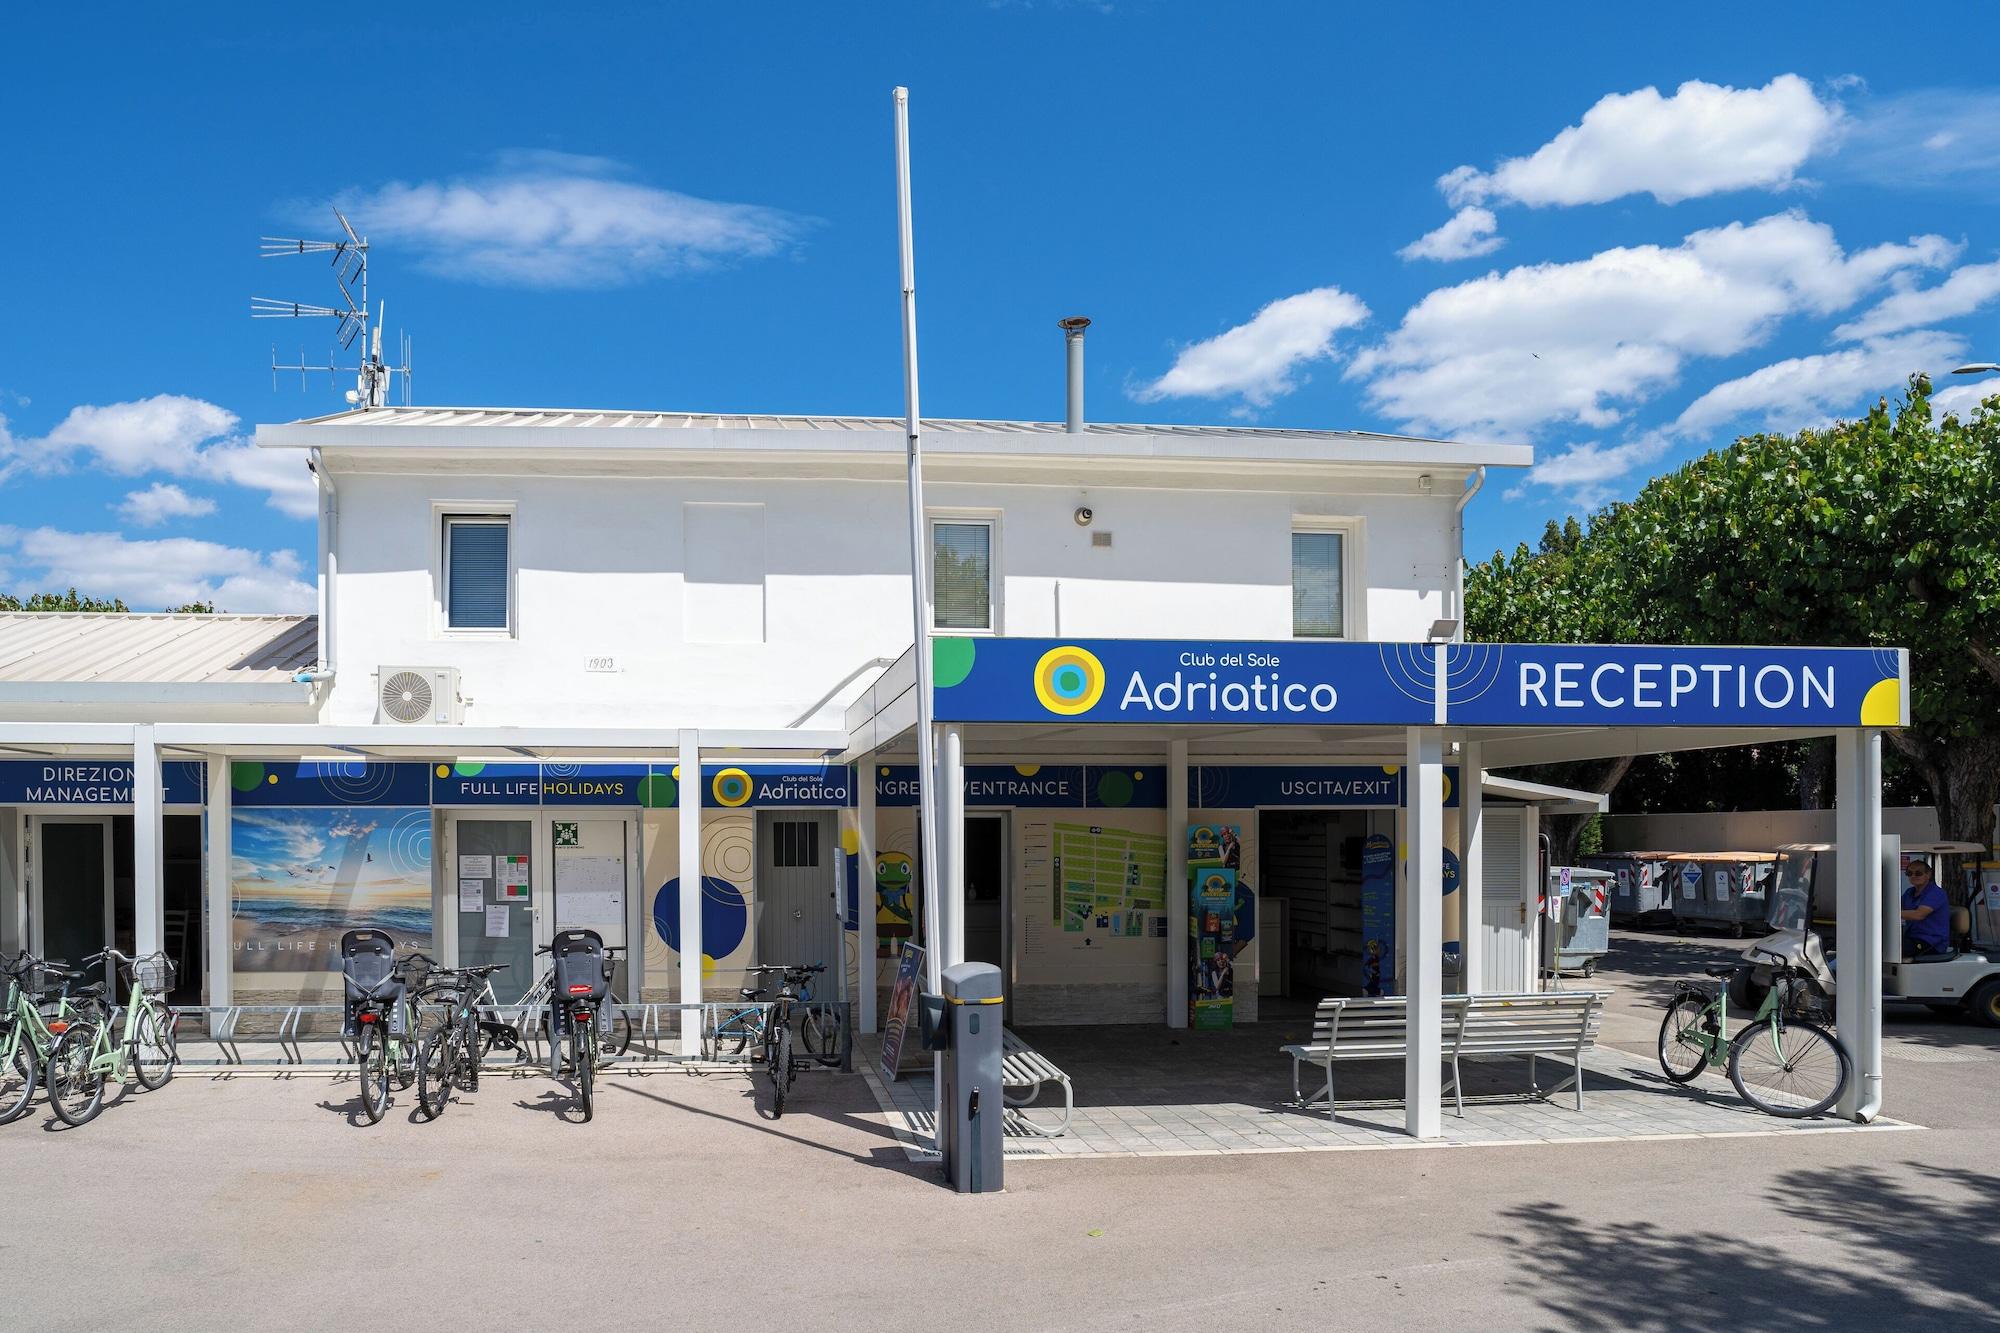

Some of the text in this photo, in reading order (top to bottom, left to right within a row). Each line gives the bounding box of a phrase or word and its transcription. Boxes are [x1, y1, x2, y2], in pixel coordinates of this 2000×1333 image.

[1179, 653, 1280, 667] Club del Sole
[1119, 670, 1338, 713] Adriatico
[1519, 662, 1835, 709] RECEPTION
[43, 767, 134, 782] DIREZION
[26, 787, 170, 802] MANAGEMT
[461, 782, 624, 795] FULL LIFE HOLIDAYS
[759, 783, 846, 800] Adriatico
[1281, 780, 1391, 796] USCITA/EXIT
[233, 941, 316, 951] ULL LIFE
